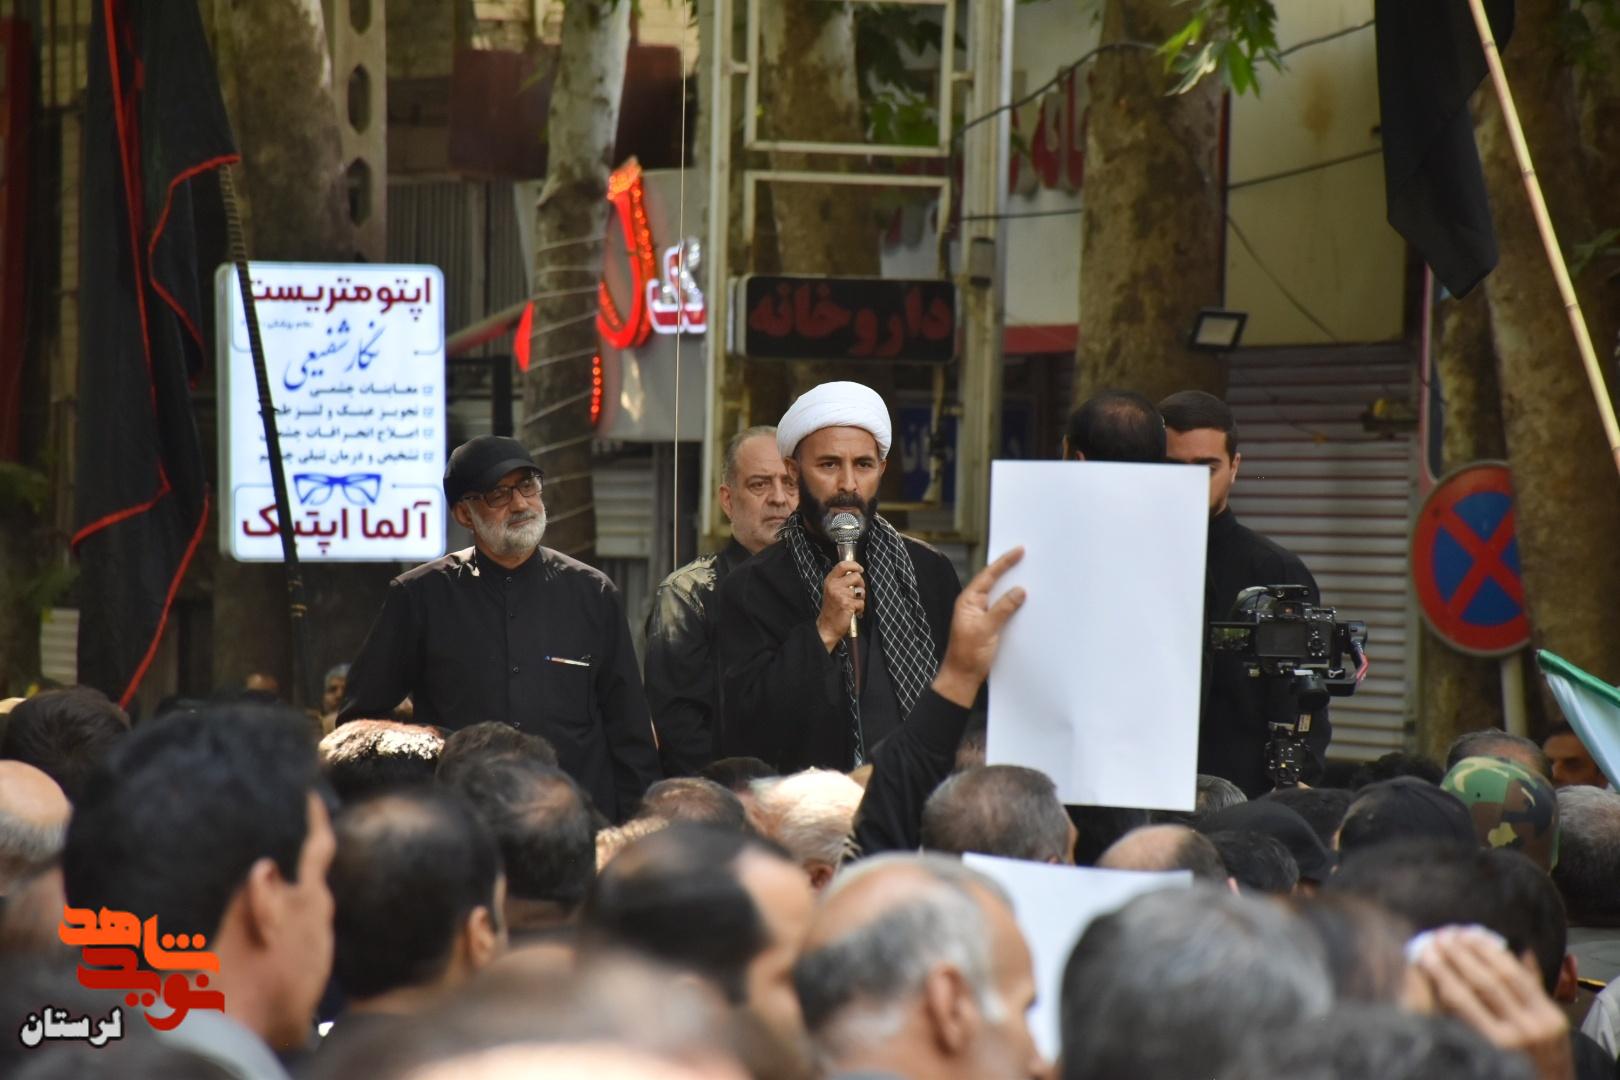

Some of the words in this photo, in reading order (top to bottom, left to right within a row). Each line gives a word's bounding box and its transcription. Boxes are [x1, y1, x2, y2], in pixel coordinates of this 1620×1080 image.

[750, 283, 951, 356] داروخانه
[283, 318, 351, 391] شفیعی
[327, 409, 333, 421] و
[337, 405, 374, 418] عینک
[329, 450, 363, 465] درمان
[368, 454, 373, 463] و
[361, 501, 432, 539] آلما
